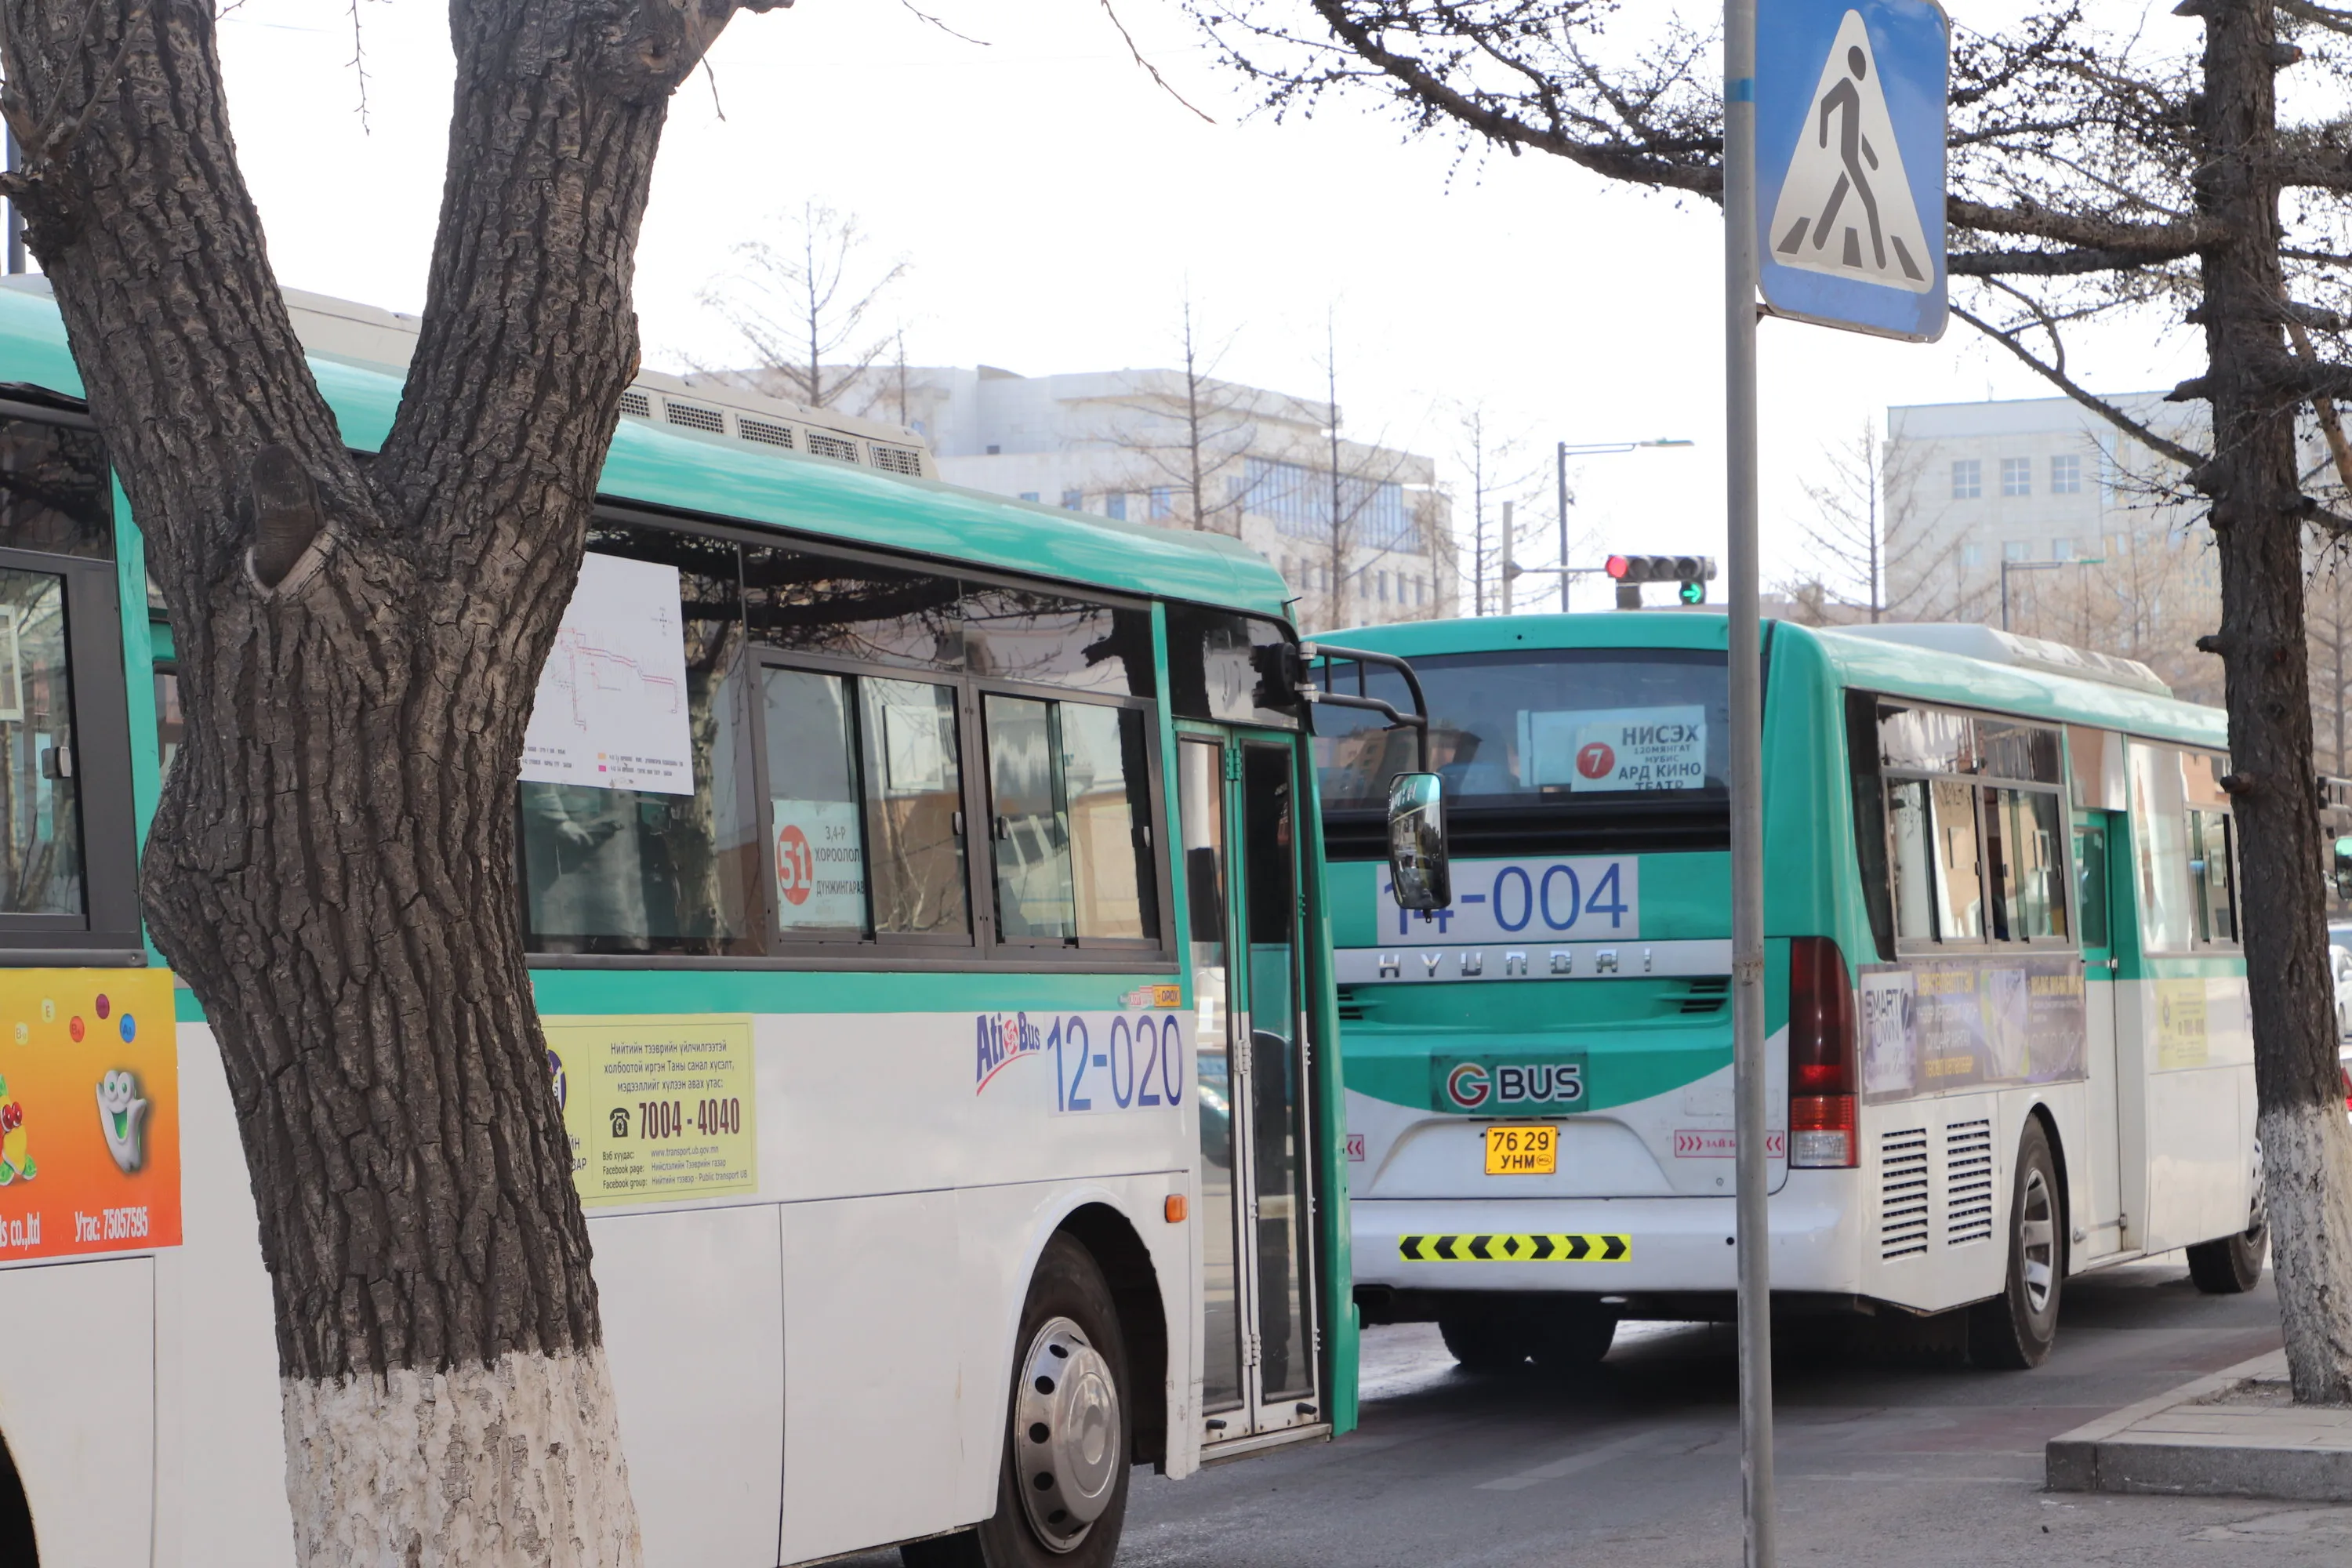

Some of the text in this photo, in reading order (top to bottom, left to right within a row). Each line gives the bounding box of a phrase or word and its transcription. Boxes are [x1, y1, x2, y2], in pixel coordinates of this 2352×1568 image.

[1622, 724, 1700, 746] НИСЭХ
[1634, 744, 1690, 754] 120МЯНГАТ
[1588, 749, 1604, 772] 7
[1618, 763, 1701, 781] АРД КИНО
[779, 841, 811, 889] 51
[815, 848, 860, 862] ХОРООЛОЛ
[1379, 948, 1651, 978] HYUNDAI
[1865, 989, 1899, 1018] SMART
[611, 1042, 643, 1054] Нийтийн
[644, 1041, 677, 1056] тээврийн
[604, 1060, 643, 1074] холбоотой
[645, 1062, 666, 1075] иргэн
[666, 1060, 686, 1072] Таны
[688, 1061, 708, 1072] санал
[1047, 1014, 1183, 1112] 12-020
[618, 1078, 660, 1094] мэдээллийг
[688, 1079, 704, 1089] авах
[706, 1079, 723, 1091] утас:
[1447, 1064, 1581, 1106] G BUS
[639, 1101, 682, 1140] 7004
[697, 1098, 740, 1136] 4040
[1494, 1131, 1549, 1152] 76 29
[602, 1145, 719, 1162] Вэб хуудас: www.transport.ub.gov.mn
[1501, 1154, 1535, 1169] УНМ
[602, 1164, 628, 1175] Facebook
[629, 1165, 644, 1177] page:
[603, 1179, 629, 1189] Facebook
[630, 1179, 648, 1190] group:
[715, 1171, 739, 1181] transport
[103, 1207, 148, 1240] 75057595
